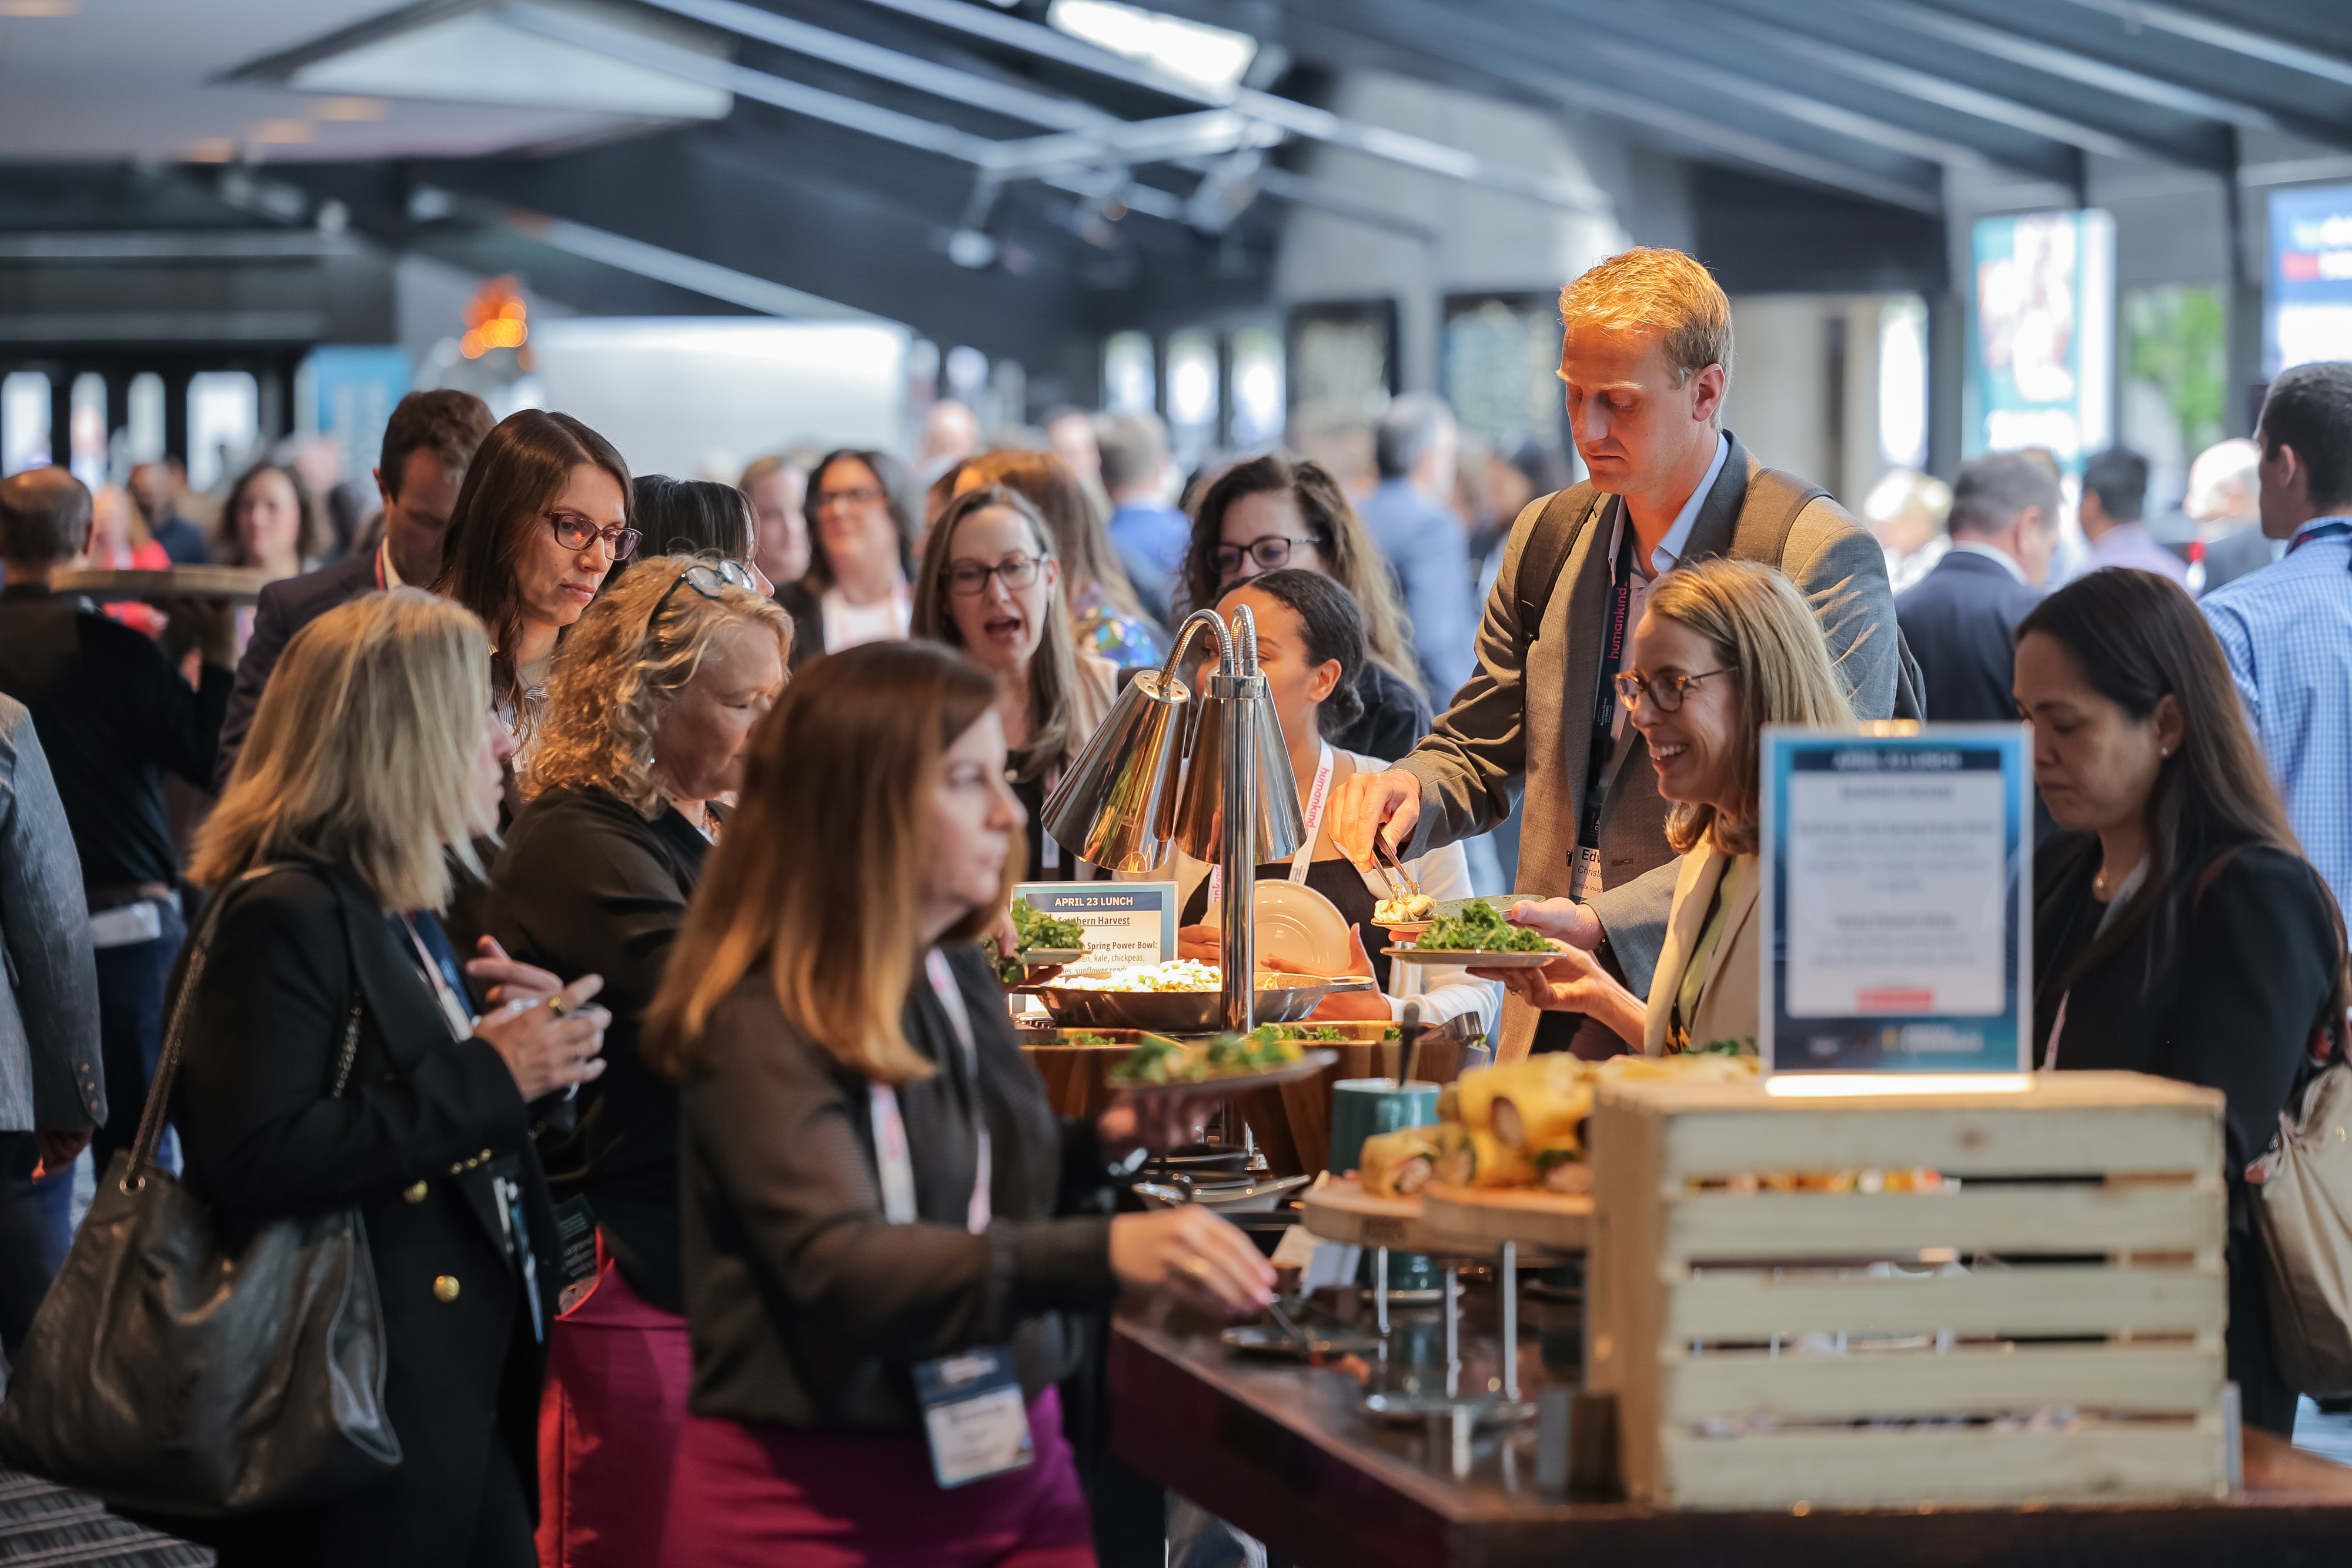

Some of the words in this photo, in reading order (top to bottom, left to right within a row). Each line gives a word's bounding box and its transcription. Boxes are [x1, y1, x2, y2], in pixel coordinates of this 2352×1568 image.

[1607, 587, 1627, 658] humankind
[1307, 767, 1330, 828] humankind
[1573, 881, 1588, 890] Scripta
[1055, 897, 1084, 907] APRIL
[1086, 897, 1098, 906] 23
[1100, 897, 1133, 906] LUNCH
[1098, 917, 1130, 925] Harvest
[1088, 942, 1111, 951] Spring
[1112, 941, 1135, 950] Power
[1137, 941, 1158, 949] Bowl:
[1094, 954, 1110, 963] kale,
[1111, 954, 1145, 963] chickpeas,
[1075, 966, 1108, 974] sunflower
